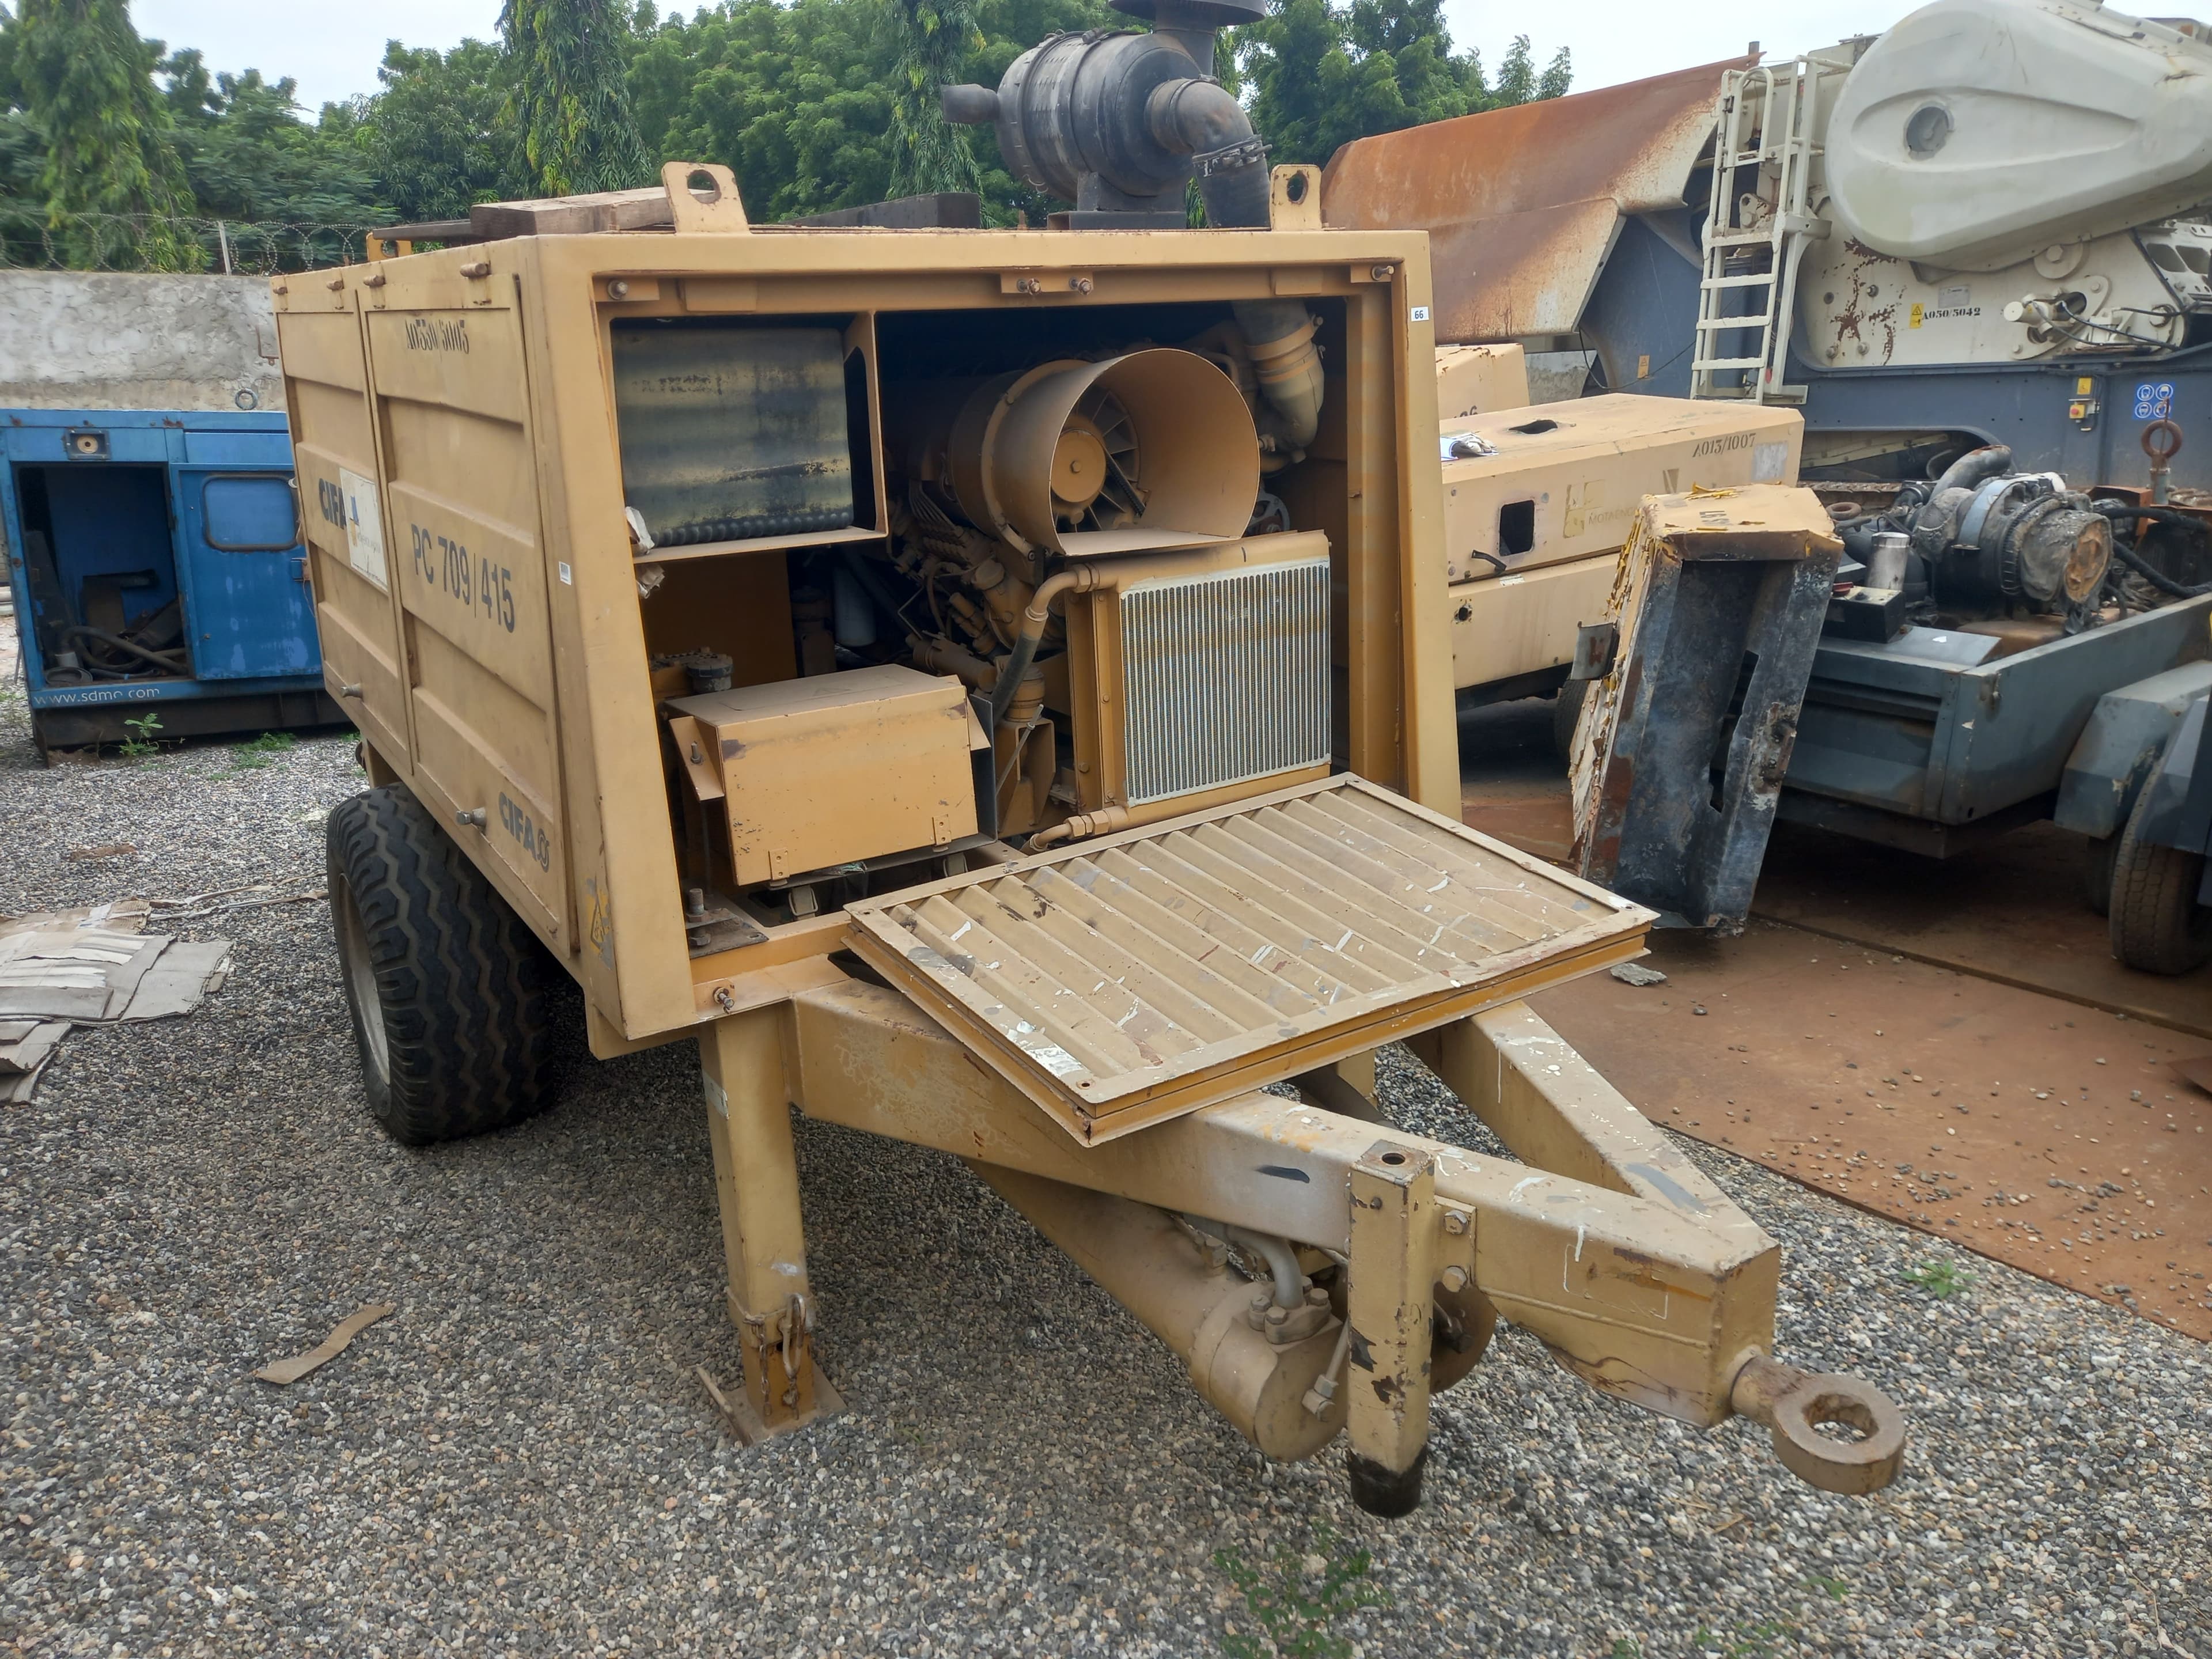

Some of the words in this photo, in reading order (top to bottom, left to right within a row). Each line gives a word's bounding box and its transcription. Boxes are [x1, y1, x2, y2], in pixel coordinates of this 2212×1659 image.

[1415, 310, 1424, 319] 66
[1692, 433, 1756, 457] A013/1007
[411, 524, 434, 587] PC
[438, 535, 515, 634] 709/415
[33, 688, 160, 704] www.sdmocom
[498, 791, 537, 862] CIFA
